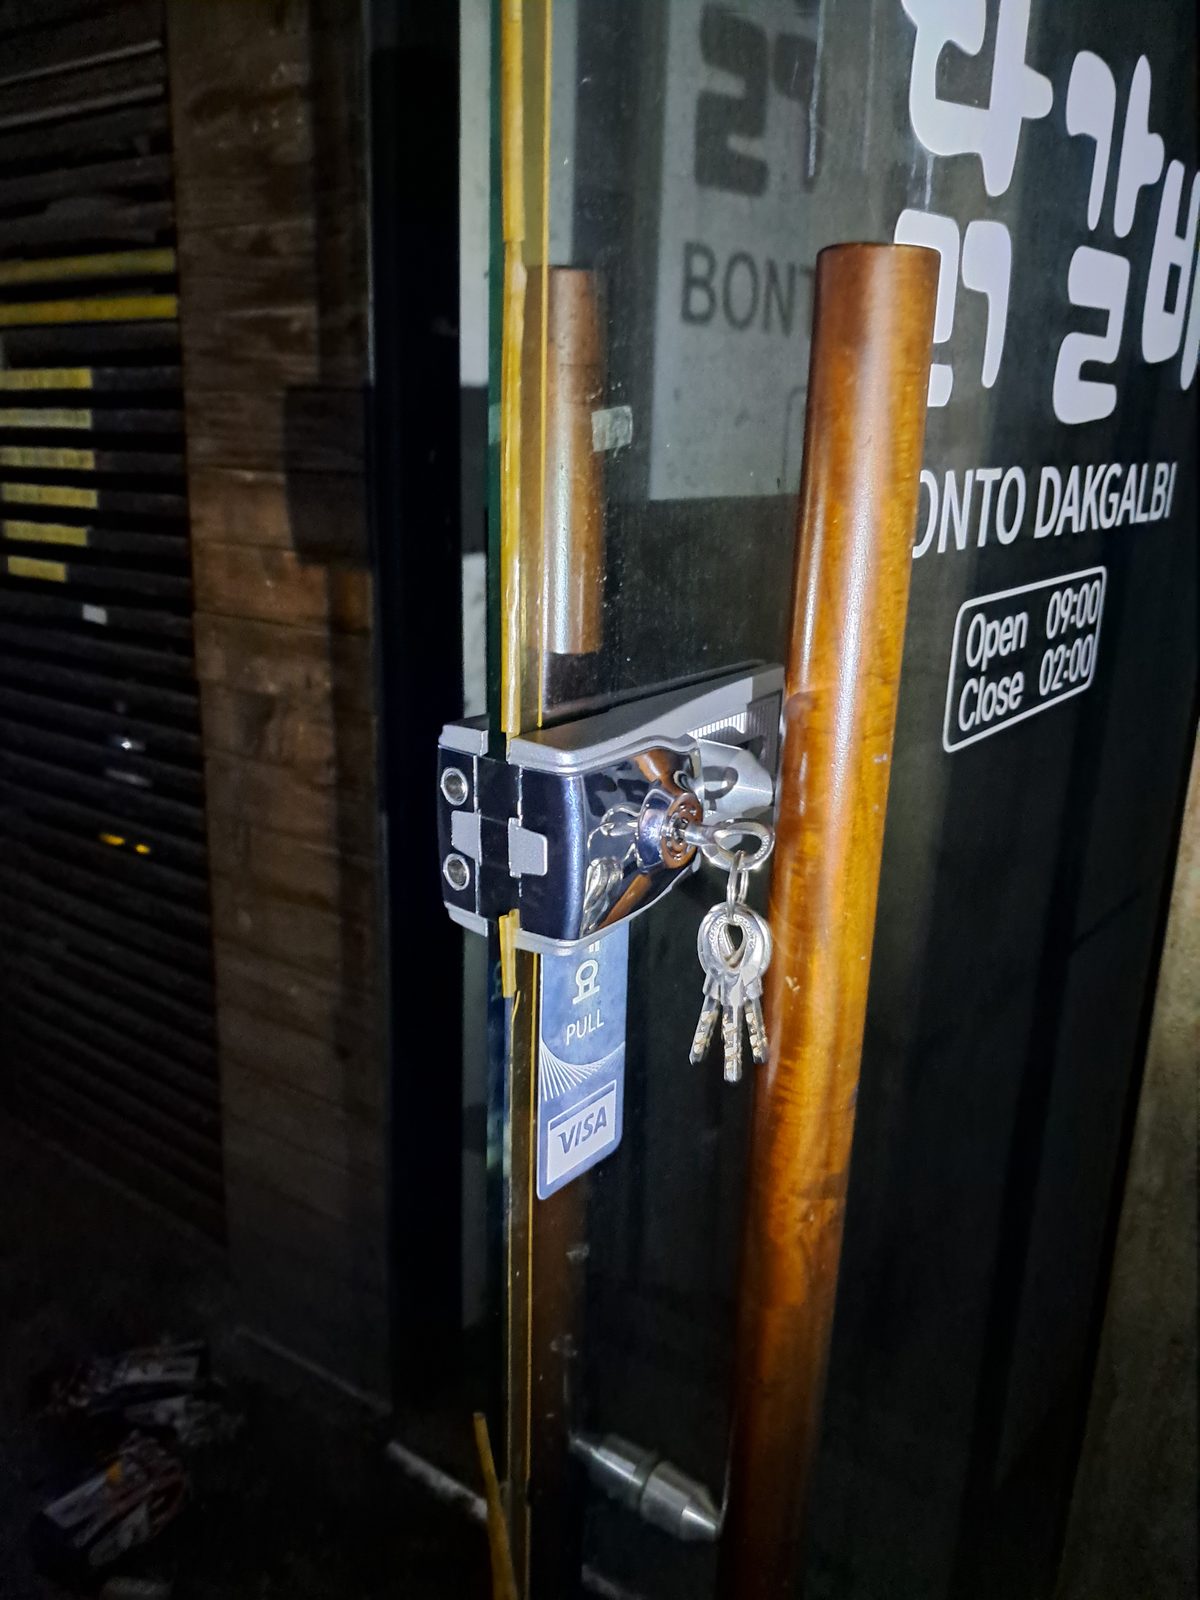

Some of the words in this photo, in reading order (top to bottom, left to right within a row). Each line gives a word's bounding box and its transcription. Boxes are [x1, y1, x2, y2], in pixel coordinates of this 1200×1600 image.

[1034, 462, 1177, 538] DAKGALBI
[965, 612, 1028, 671] Open
[1046, 580, 1101, 639] 09:00
[958, 671, 1024, 731] Close
[1039, 634, 1094, 696] 02:00
[573, 940, 600, 1005] 요
[565, 1008, 604, 1046] PULL
[558, 1106, 607, 1154] VISA
